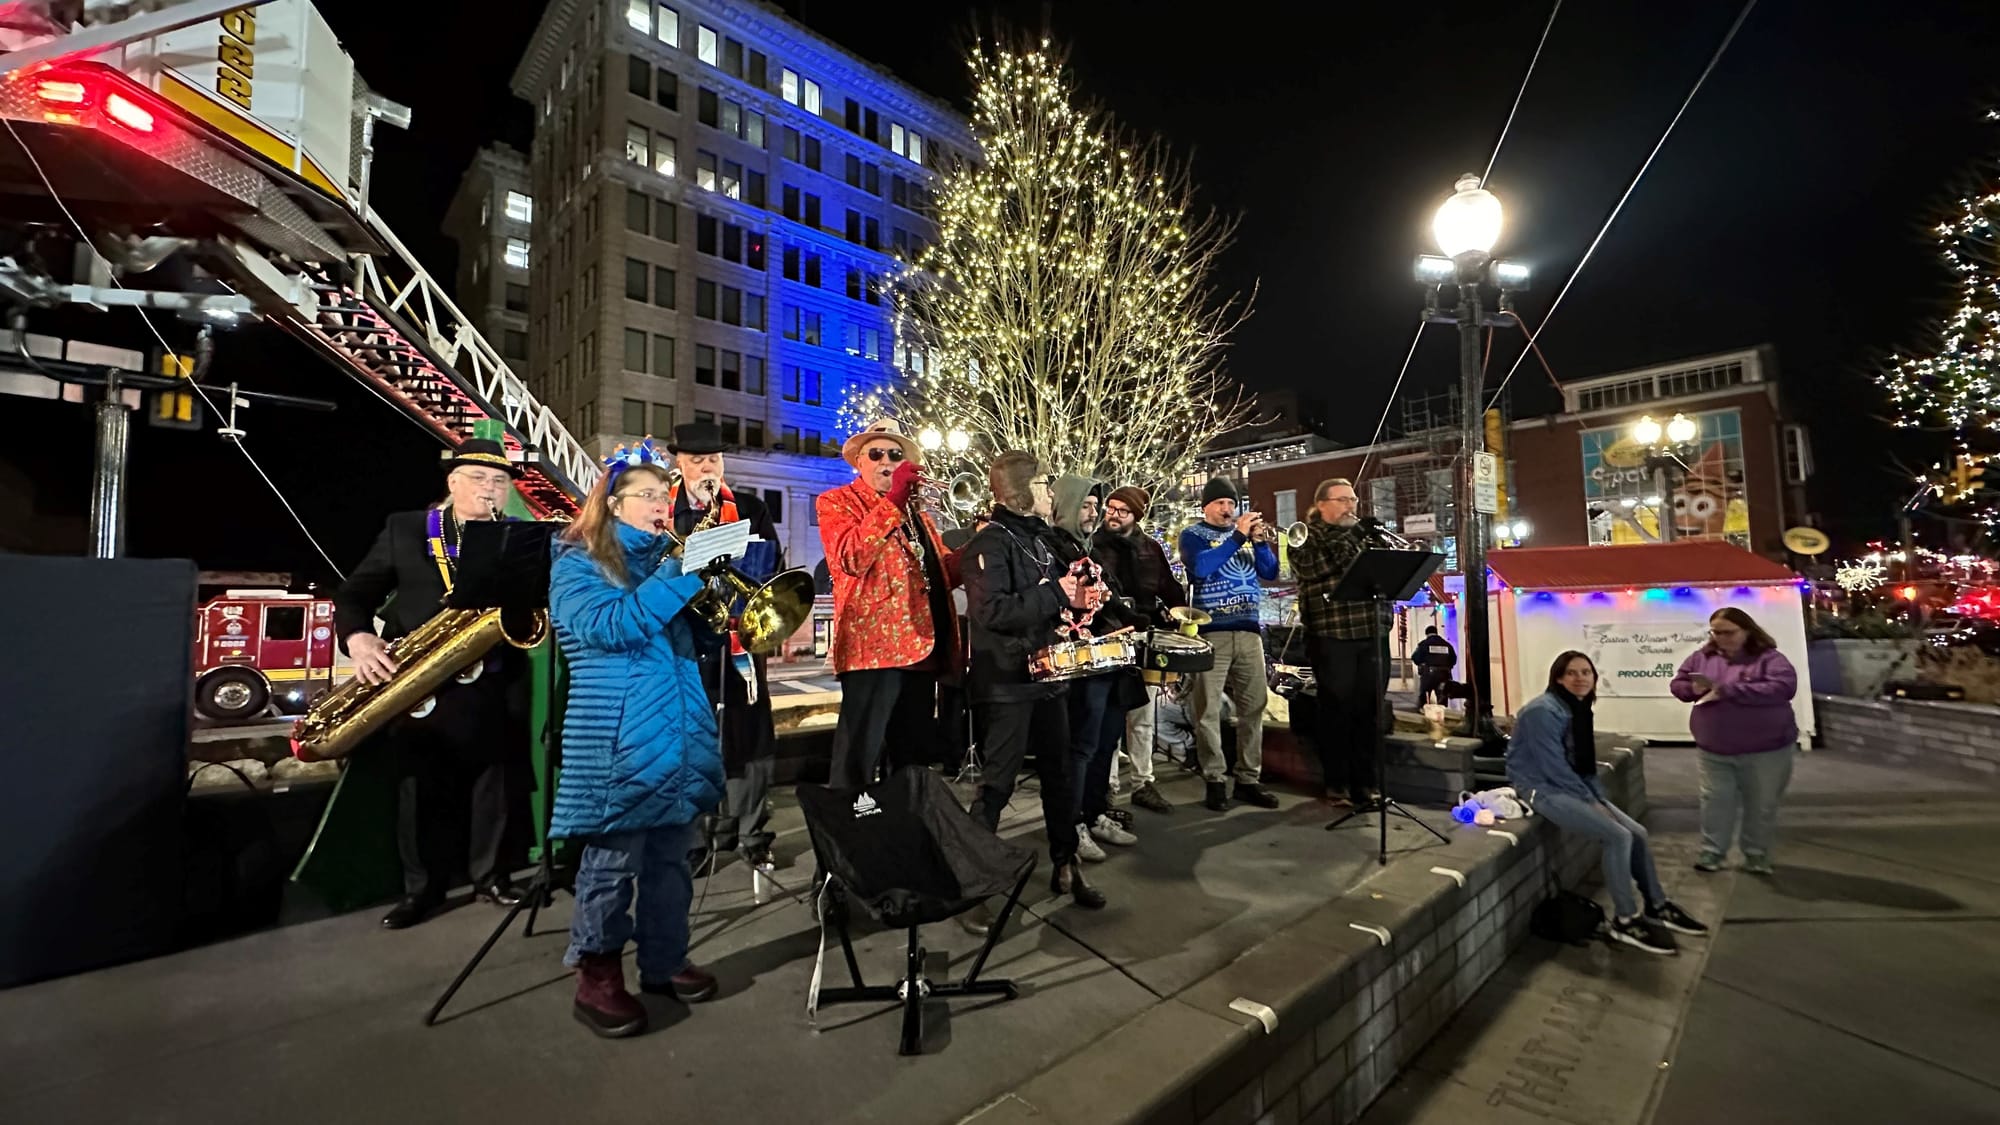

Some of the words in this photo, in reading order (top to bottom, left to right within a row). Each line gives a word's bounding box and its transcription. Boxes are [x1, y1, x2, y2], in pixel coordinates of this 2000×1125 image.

[1220, 594, 1251, 606] LIGHT
[1600, 633, 1629, 644] Easton
[1632, 633, 1667, 643] Winter
[1638, 645, 1673, 654] Thanks
[1618, 670, 1674, 678] PRODUCTS
